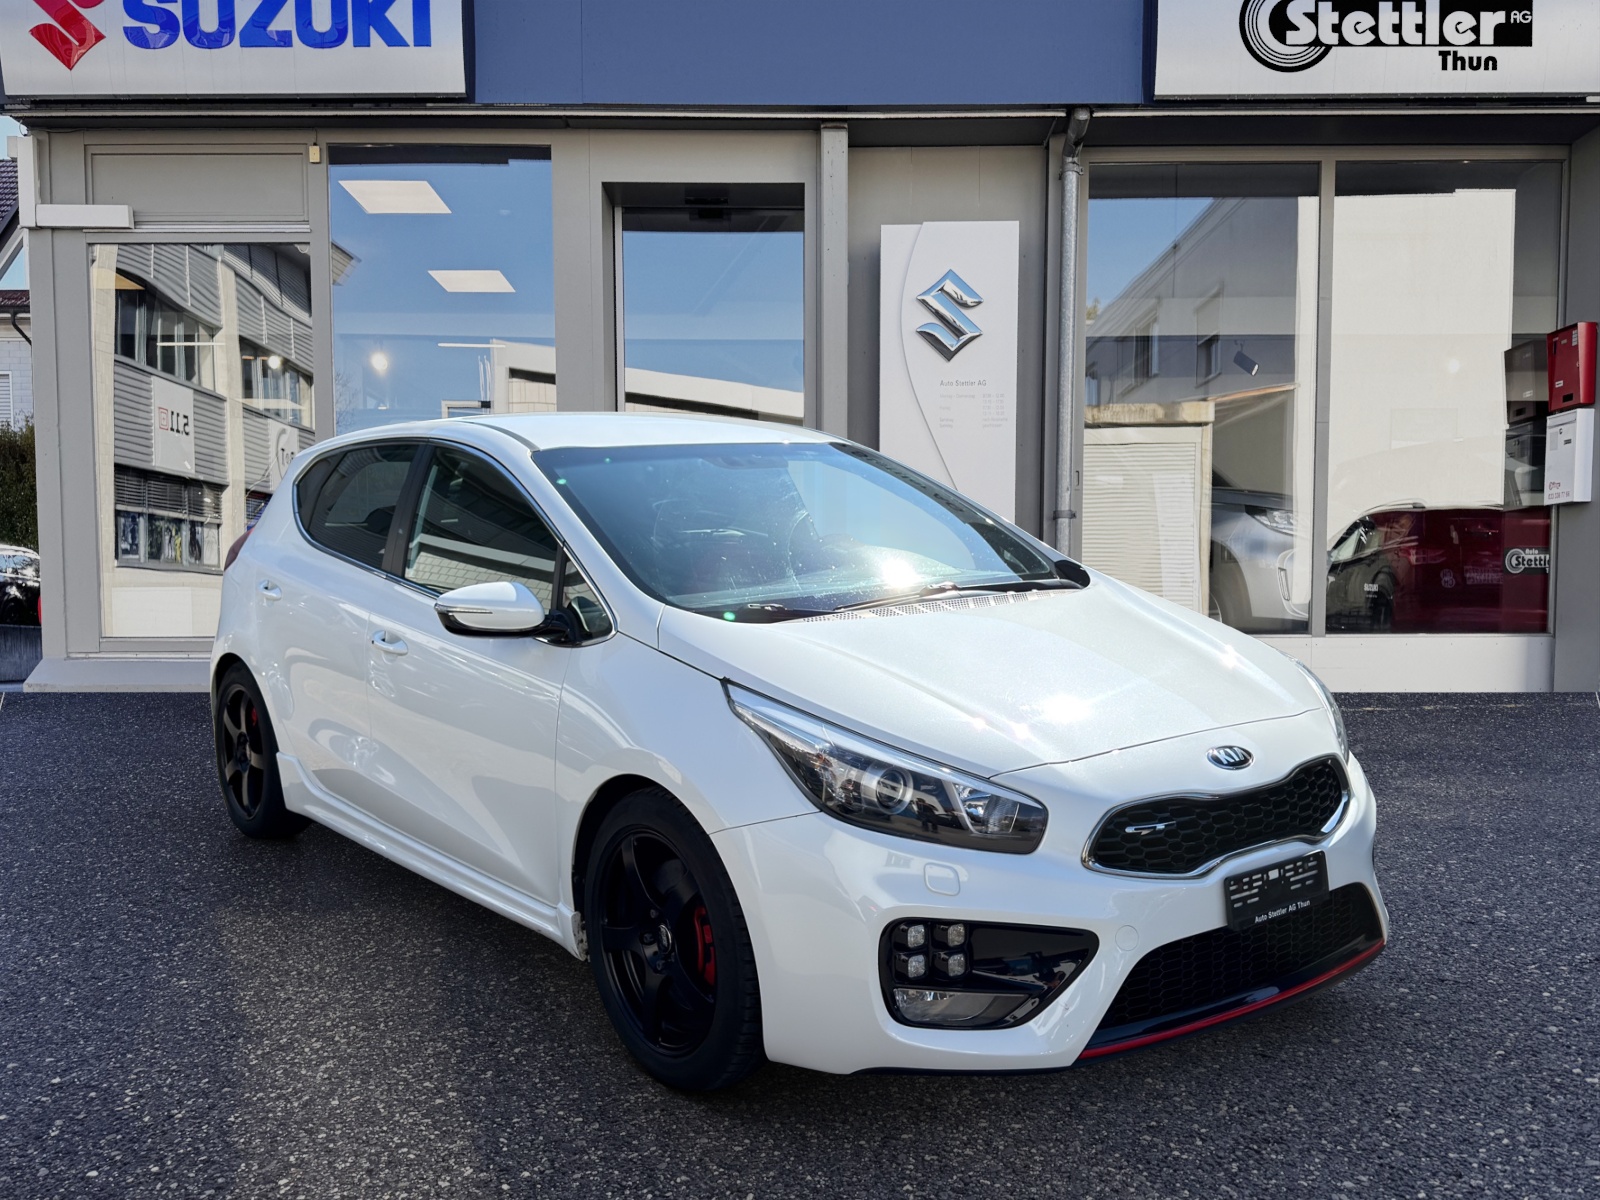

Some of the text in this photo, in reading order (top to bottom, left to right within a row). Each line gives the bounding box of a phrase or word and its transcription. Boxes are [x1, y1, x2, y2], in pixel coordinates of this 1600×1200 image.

[122, 0, 432, 49] SUZUKI
[1286, 0, 1532, 45] Stettler AG
[1438, 51, 1498, 71] Thun
[1217, 747, 1249, 765] KIA
[1255, 900, 1311, 923] Auto Stettler AG Thun
